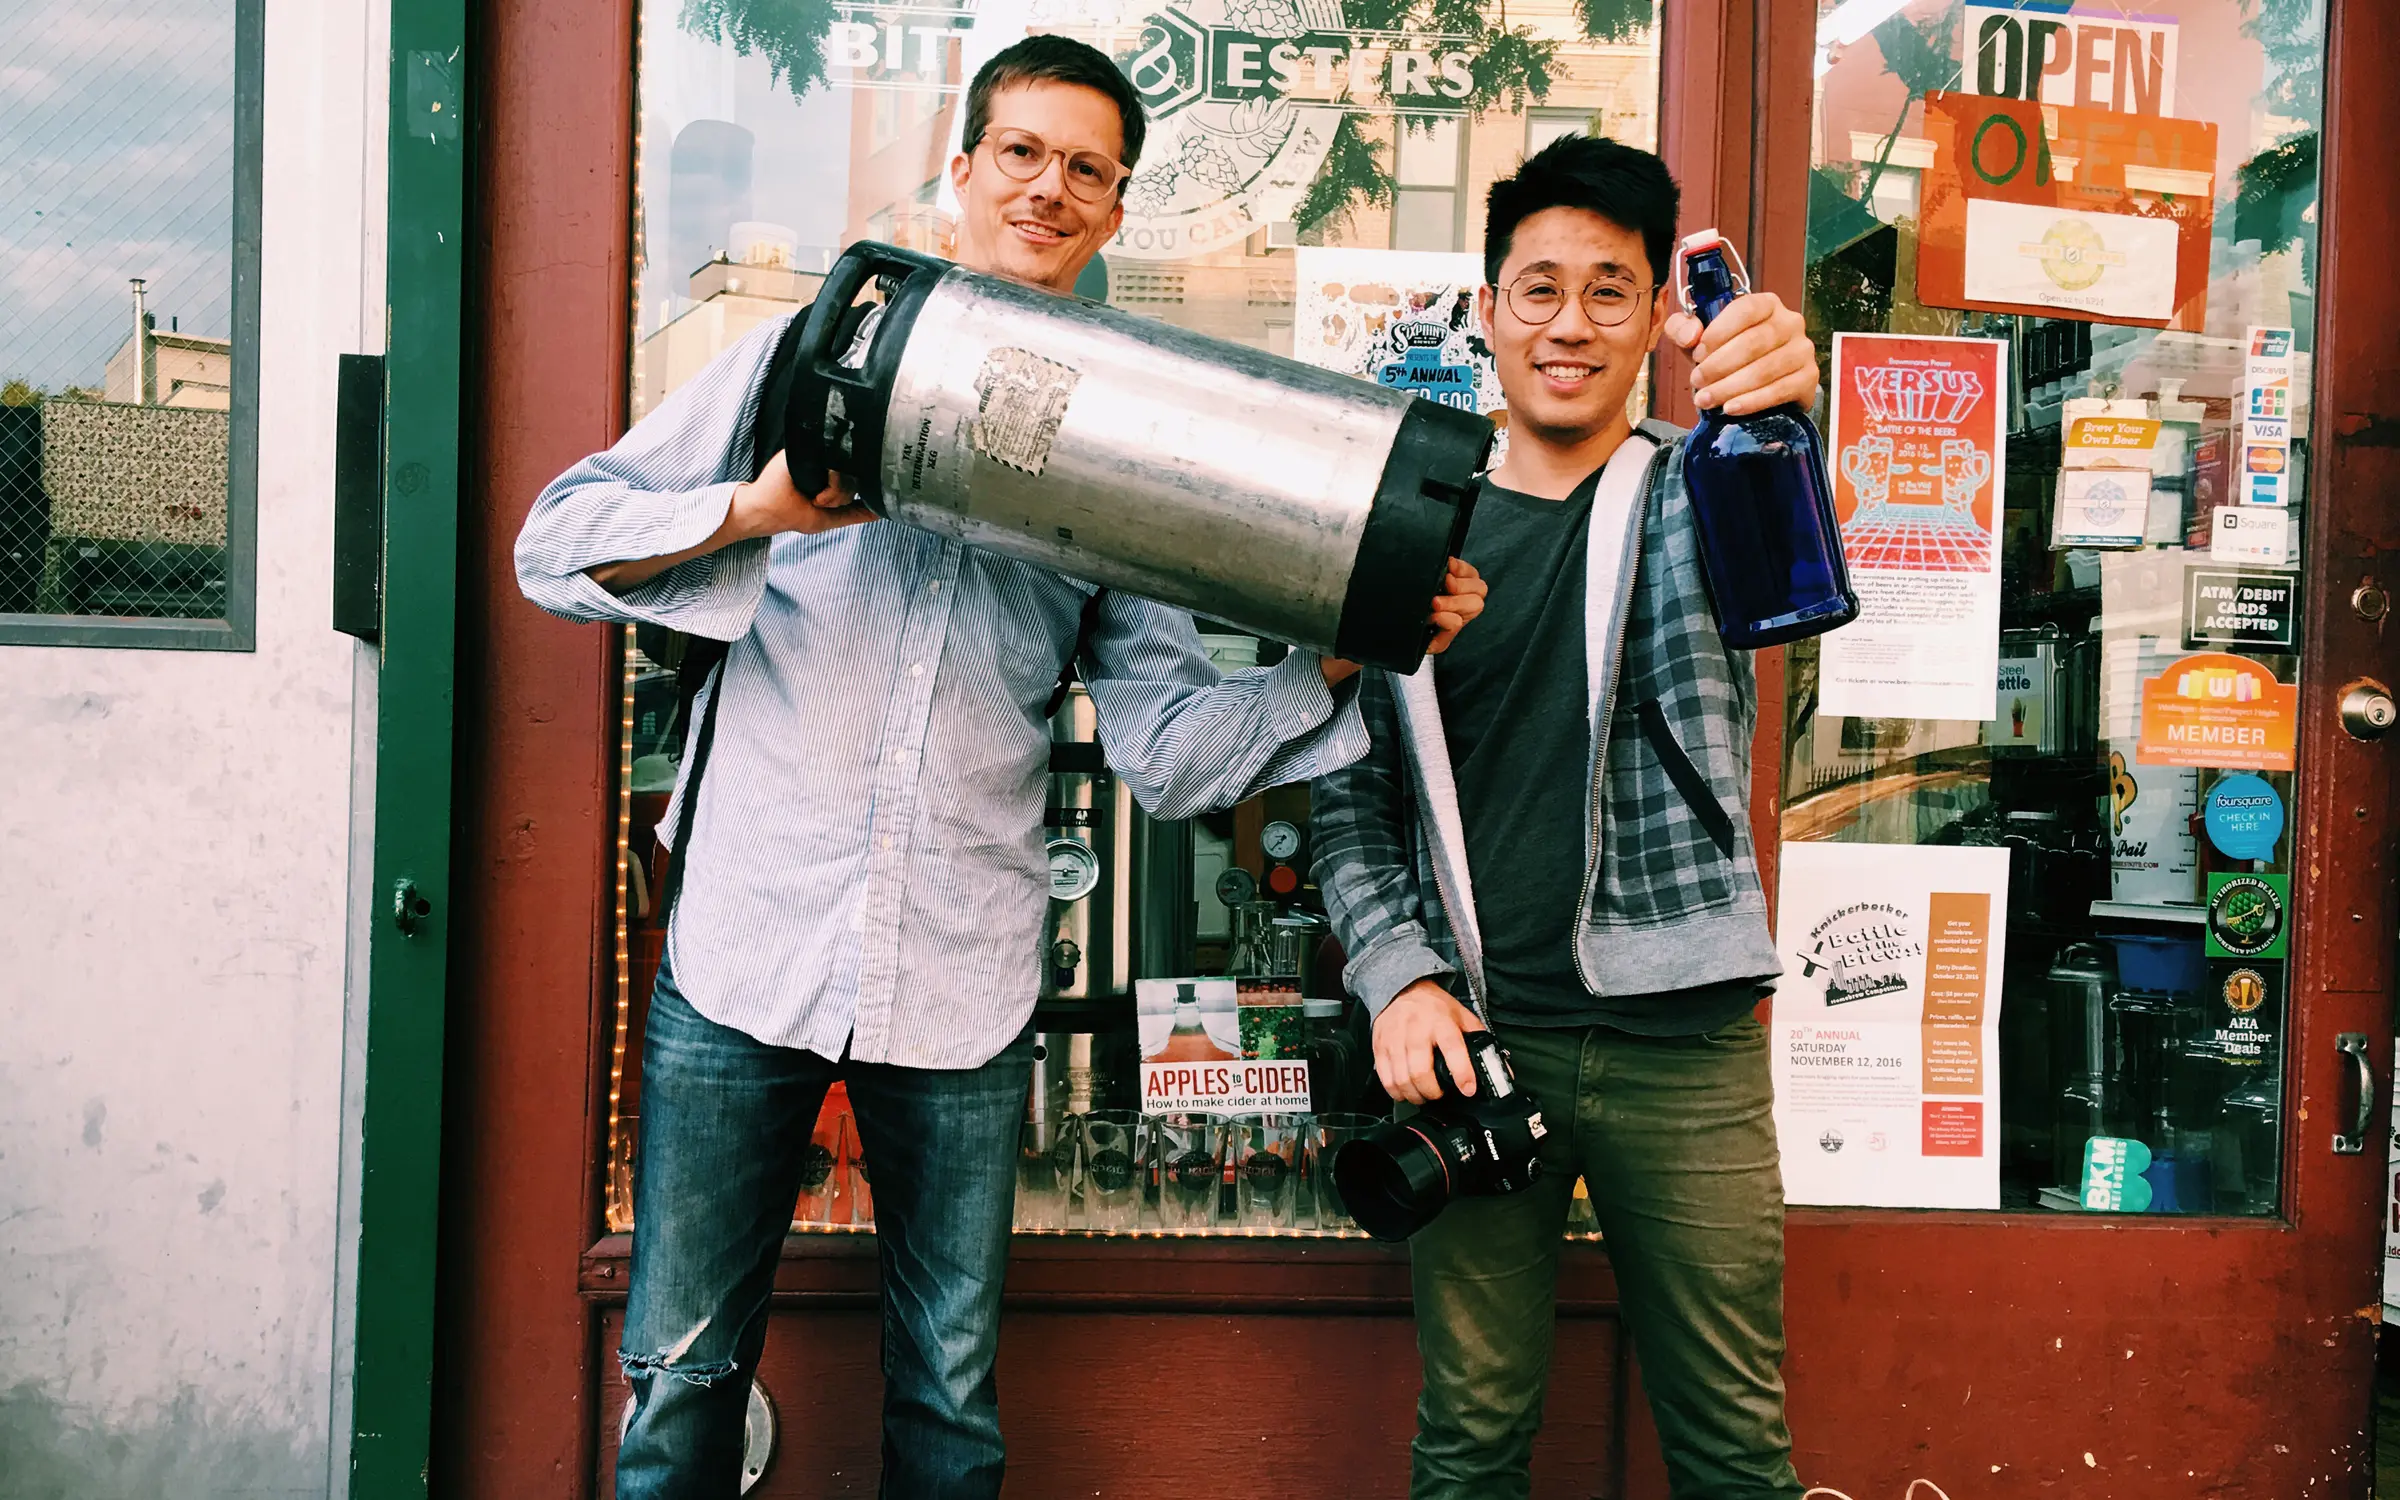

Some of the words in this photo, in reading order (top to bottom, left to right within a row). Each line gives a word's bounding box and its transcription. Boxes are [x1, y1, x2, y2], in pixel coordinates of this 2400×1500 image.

[1227, 42, 1474, 99] ESTERS
[1977, 14, 2165, 118] OPEN
[1115, 226, 1178, 250] YOU
[1188, 203, 1254, 244] CAN
[1409, 367, 1462, 384] ANNUAL
[2251, 366, 2287, 375] DISCOVER
[1855, 366, 1984, 408] VERSUS
[1877, 424, 1902, 435] BATTLE
[1904, 425, 1916, 435] OF
[1918, 426, 1932, 436] THE
[1934, 427, 1957, 436] BEERS
[2083, 422, 2115, 433] Brew
[2118, 423, 2147, 434] Your
[2253, 424, 2283, 438] VISA
[2082, 433, 2111, 445] Own
[2113, 435, 2141, 446] Beer
[903, 443, 913, 460] TAX
[2240, 517, 2277, 530] Square
[2199, 586, 2286, 602] ATM/DEBIT
[2217, 602, 2268, 616] CARDS
[2204, 616, 2279, 631] ACCEPTED
[1998, 664, 2025, 677] Steel
[1997, 675, 2031, 691] ettle
[2167, 724, 2265, 745] MEMBER
[2216, 794, 2272, 810] foursquare
[2219, 812, 2256, 822] CHECK
[2259, 812, 2271, 820] IN
[2231, 822, 2260, 831] HERE
[2116, 840, 2148, 857] Pail
[2212, 877, 2257, 909] AUTHORIZED
[2257, 878, 2281, 910] DEALER
[1810, 902, 1909, 940] Knickerbocker
[1829, 923, 1908, 948] Battle
[1841, 942, 1922, 968] Brews!
[1830, 991, 1864, 1004] Homebrew
[1865, 984, 1905, 996] Competition
[2229, 1017, 2259, 1029] AHA
[1790, 1026, 1812, 1039] 20TH
[1815, 1030, 1862, 1040] ANNUAL
[2215, 1030, 2272, 1043] Member
[1790, 1043, 1847, 1053] SATURDAY
[2224, 1043, 2261, 1055] Deals
[1790, 1056, 1854, 1066] NOVEMBER
[1857, 1057, 1873, 1068] 12,
[1876, 1057, 1902, 1067] 2016
[1147, 1068, 1230, 1098] APPLES
[1232, 1073, 1243, 1086] to
[1244, 1066, 1308, 1095] CIDER
[1147, 1098, 1172, 1110] How
[1176, 1098, 1189, 1108] to
[1192, 1097, 1224, 1108] make
[1227, 1096, 1257, 1107] cider
[1260, 1096, 1272, 1106] at
[1275, 1095, 1309, 1106] home
[1484, 1129, 1500, 1160] Canon
